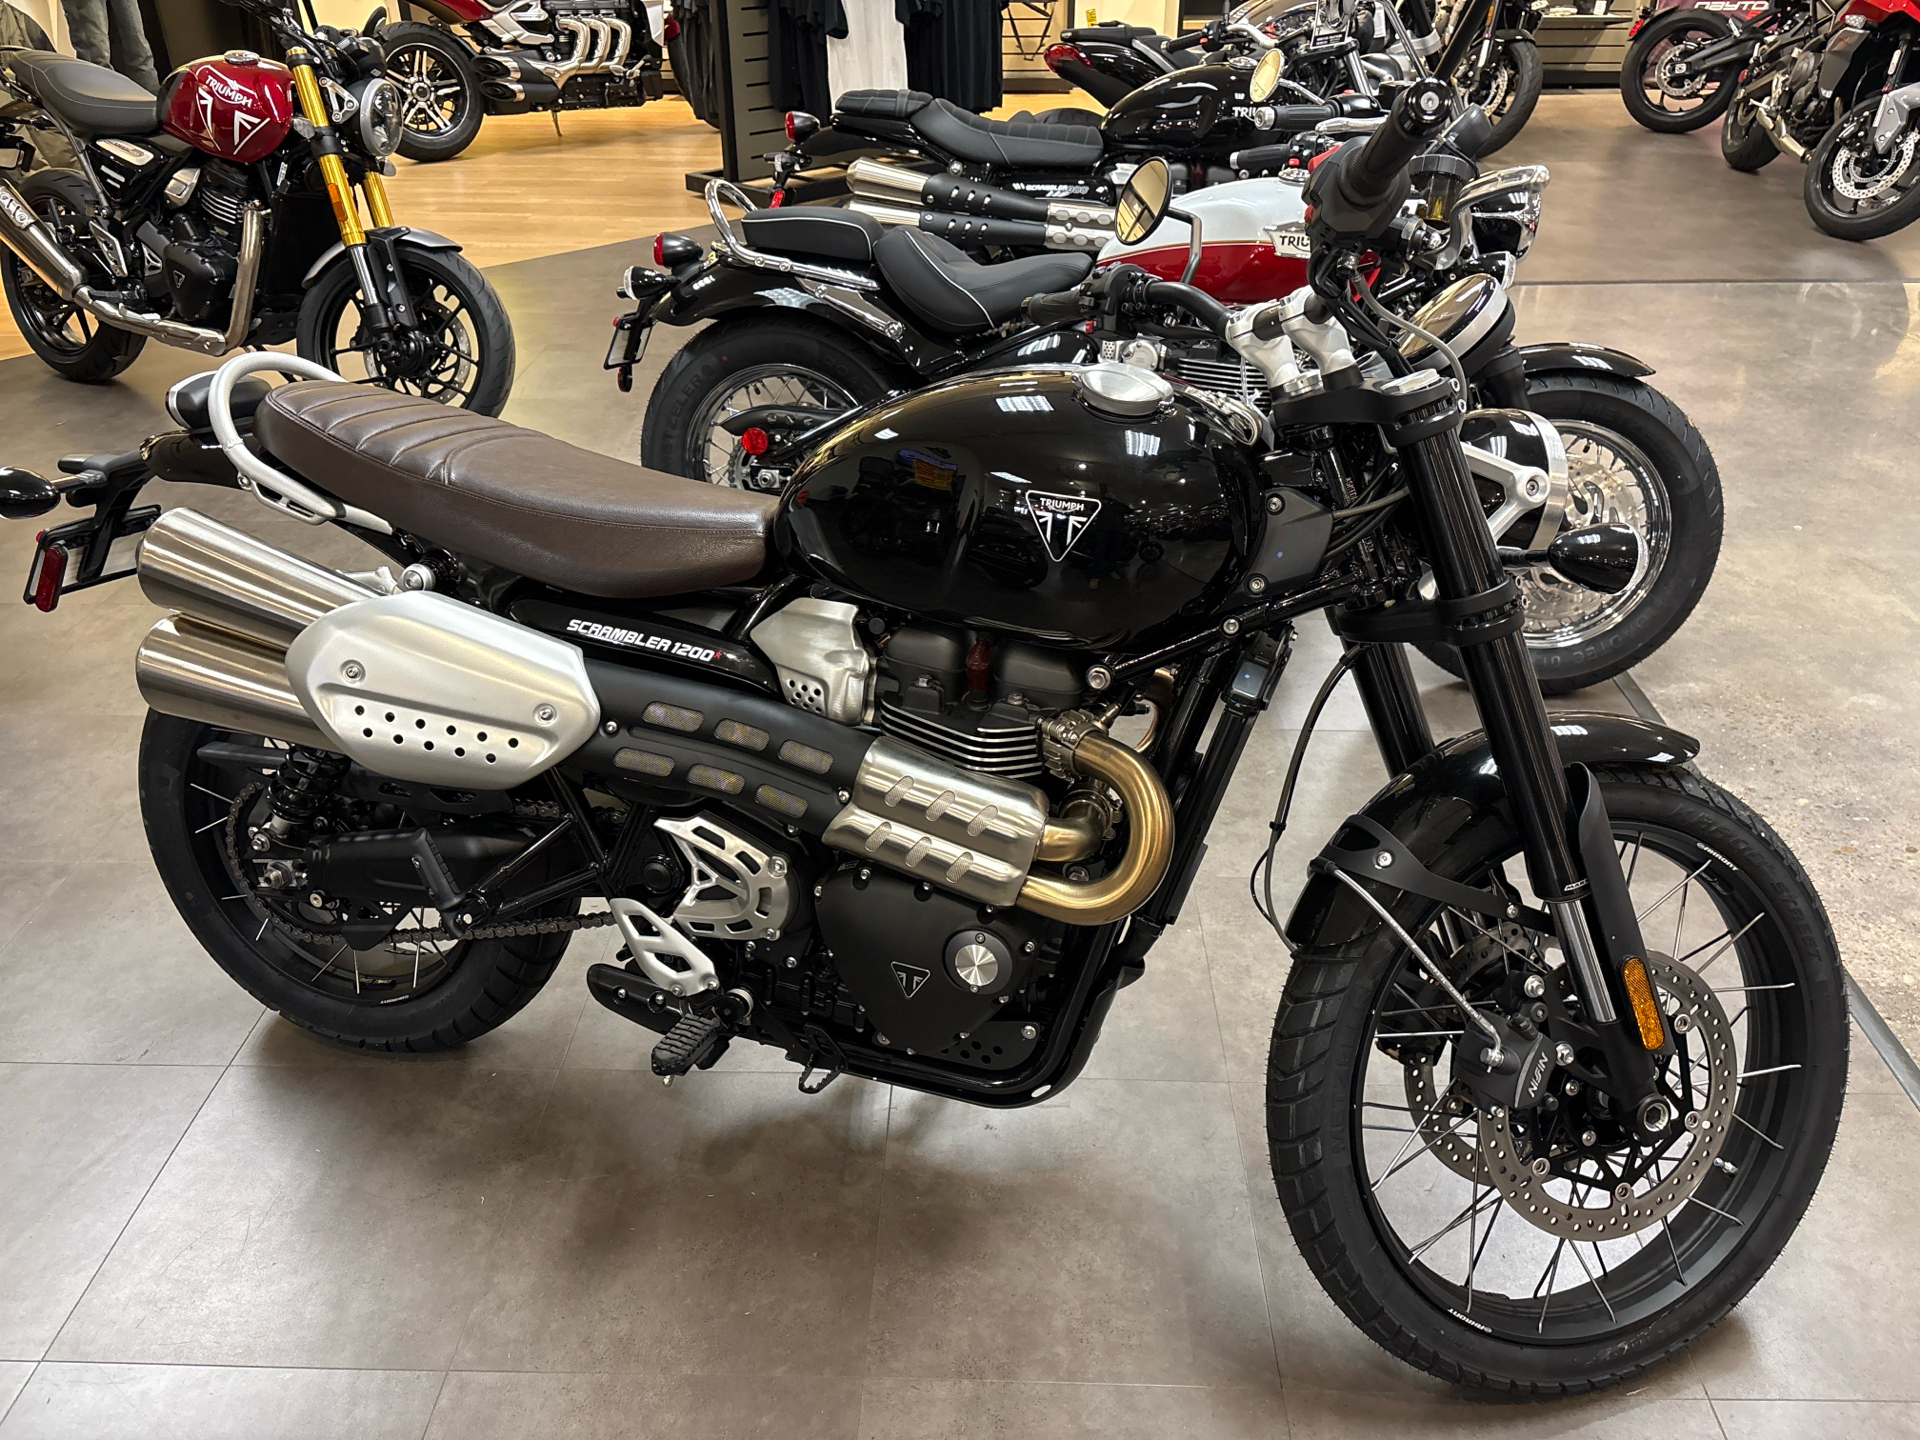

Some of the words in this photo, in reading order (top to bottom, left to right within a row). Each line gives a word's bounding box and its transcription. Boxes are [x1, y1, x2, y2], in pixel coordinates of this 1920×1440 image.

[205, 75, 253, 108] TRIUMPH
[1040, 497, 1085, 512] TRIUMPH
[566, 619, 673, 652] SCRAMBLER
[1528, 1051, 1549, 1098] NISSIN
